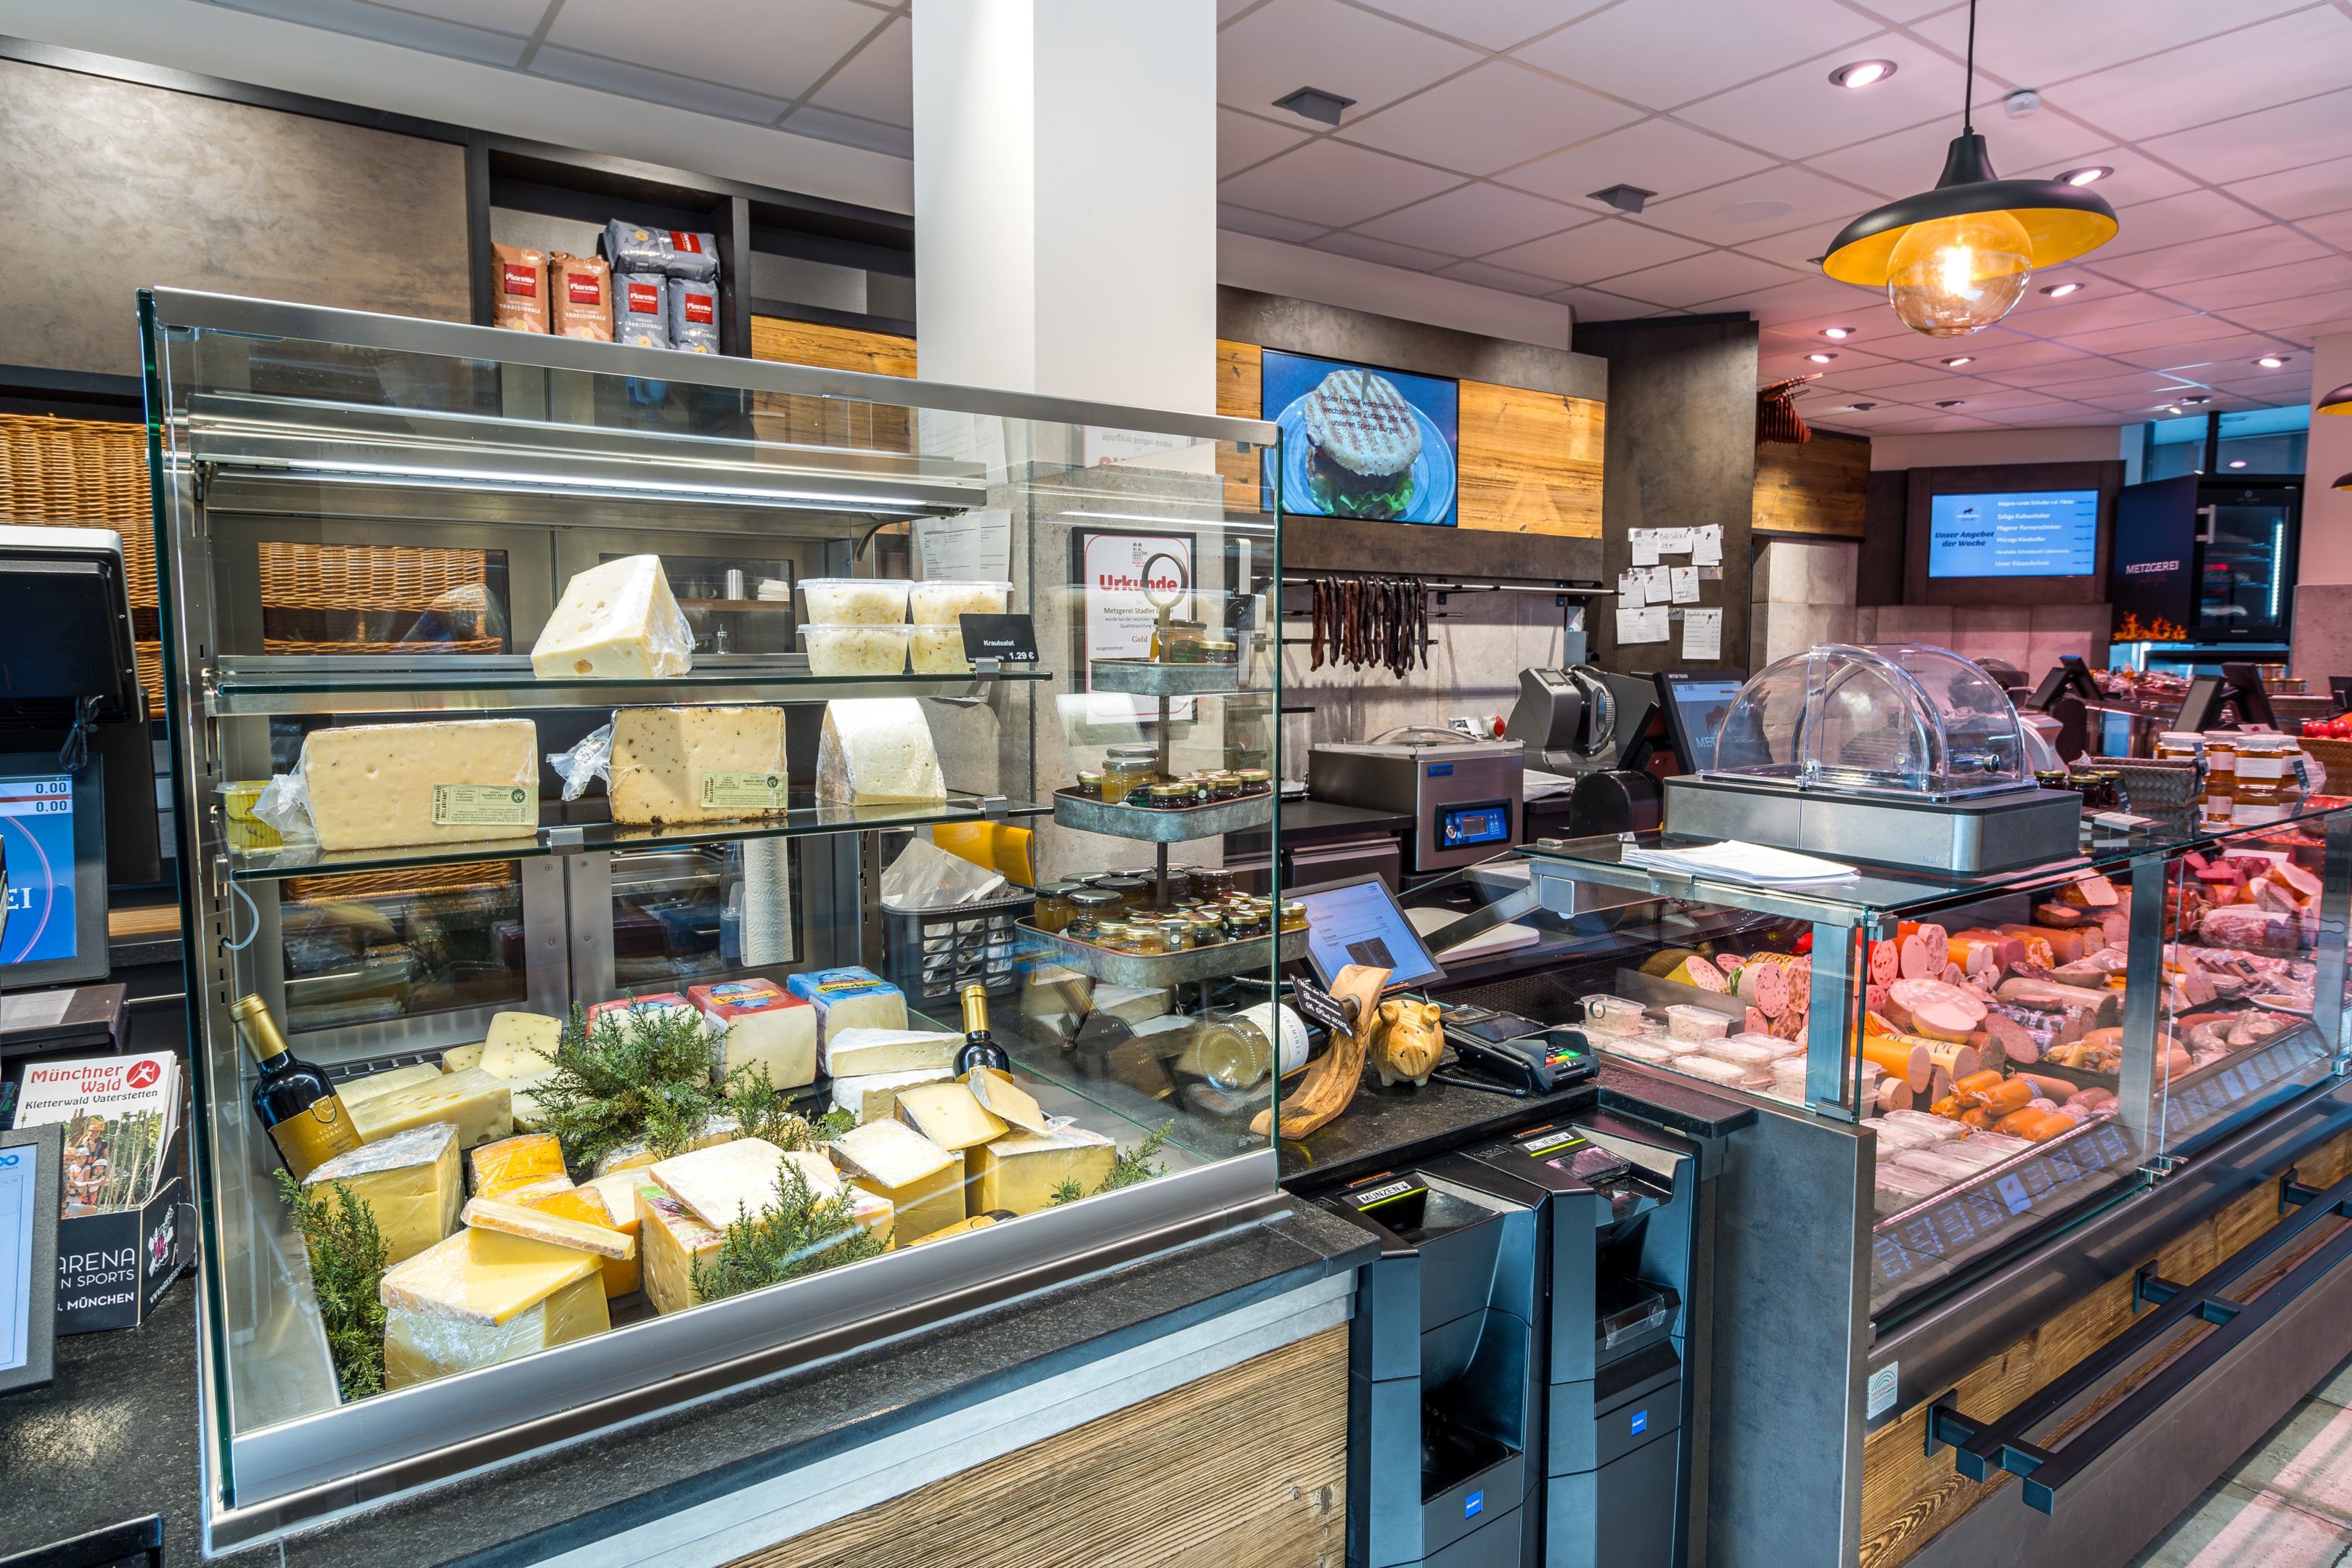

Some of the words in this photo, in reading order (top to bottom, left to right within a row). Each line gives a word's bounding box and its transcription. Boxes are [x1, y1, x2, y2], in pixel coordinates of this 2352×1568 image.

[506, 272, 535, 284] Piacetto
[570, 283, 598, 292] Piacetto
[630, 292, 656, 301] Piacetto
[499, 303, 541, 314] TRADIZIONALE
[687, 302, 711, 311] Piacetto
[565, 312, 606, 321] TRADIZIONALE
[625, 321, 662, 330] TRADIZIONALE
[1320, 393, 1338, 403] Jeden
[1339, 396, 1360, 408] Freitag
[1362, 400, 1397, 411] wöchentlich
[1322, 407, 1361, 418] wechselnden
[1363, 410, 1387, 422] Zutaten
[1388, 415, 1399, 424] gibt
[1331, 420, 1355, 428] unseren
[1357, 421, 1377, 431] Spezial
[1379, 425, 1399, 435] Burger
[1960, 531, 1995, 539] Angebot
[2126, 560, 2180, 574] METZGEREI
[1099, 574, 1177, 592] Urkunde
[1103, 608, 1134, 616] Metzgerei
[36, 783, 67, 793] 0.00
[36, 801, 67, 812] 0.00
[7, 887, 32, 910] EI
[717, 992, 770, 1003] Edamer
[30, 1065, 124, 1084] Münchner
[81, 1078, 121, 1094] Wald
[25, 1095, 89, 1109] Kletterwald
[93, 1090, 158, 1103] Vaterstetten
[1528, 1135, 1563, 1151] SCHEINE
[1361, 1185, 1400, 1204] MÜNZEN
[61, 1278, 71, 1289] N
[77, 1270, 135, 1287] SPORTS
[68, 1292, 134, 1311] MÜNCHEN
[1633, 1418, 1644, 1428] GLORY
[1466, 1498, 1480, 1510] GLORY
